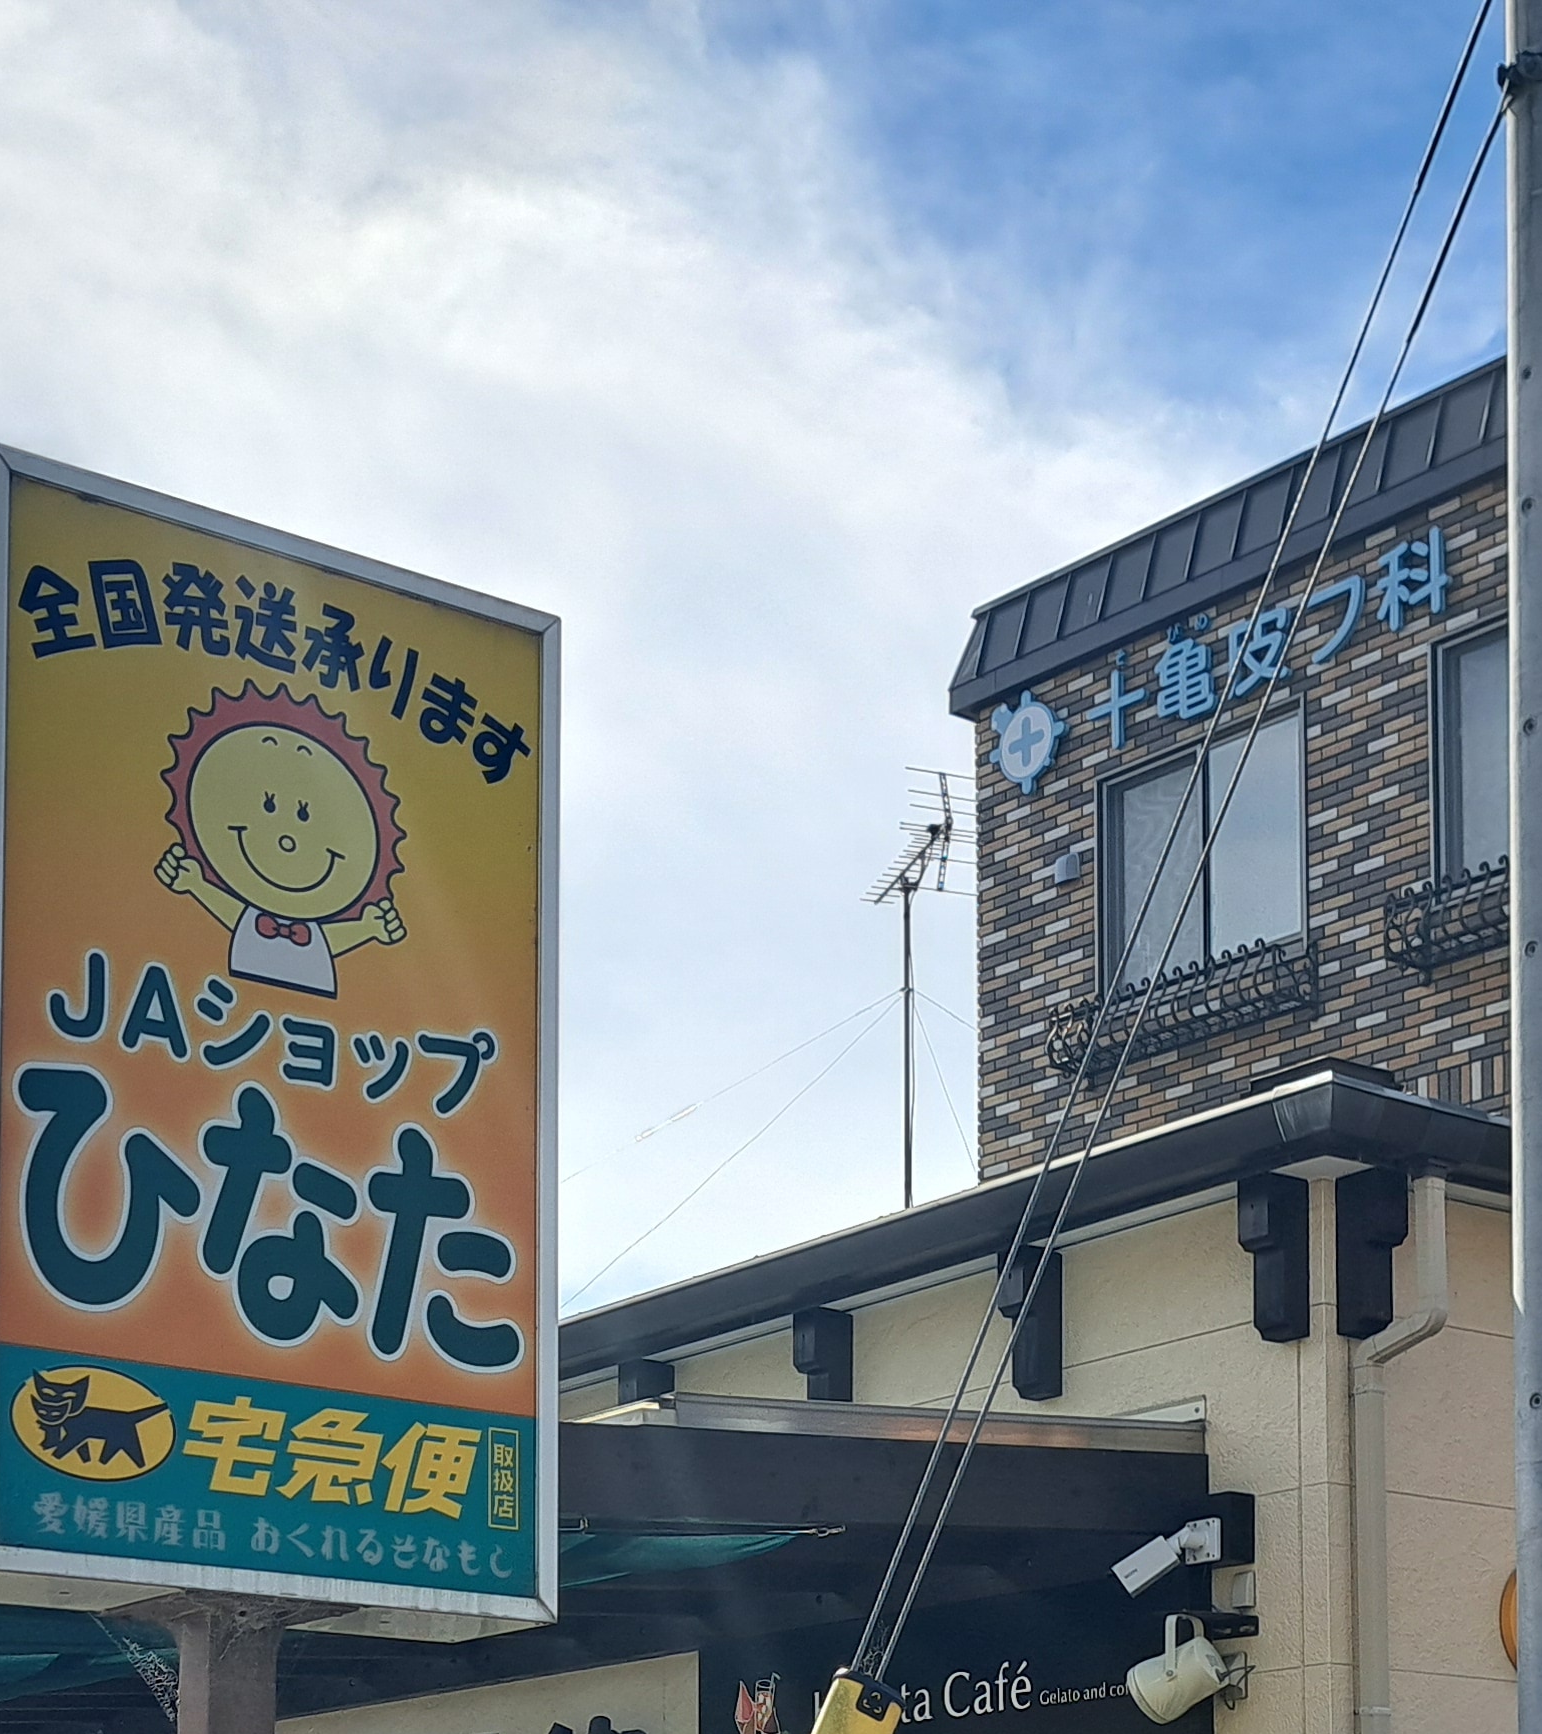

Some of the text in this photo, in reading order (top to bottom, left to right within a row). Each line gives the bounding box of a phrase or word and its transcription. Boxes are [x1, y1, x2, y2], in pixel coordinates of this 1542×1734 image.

[16, 557, 532, 785] 全国発送承ります
[1086, 525, 1452, 751] 十亀皮フ科
[49, 951, 496, 1117] JAショップ
[17, 1064, 523, 1370] ひなた
[182, 1396, 483, 1520] 宅急便
[492, 1442, 515, 1521] 取扱店
[31, 1493, 514, 1580] 愛媛県産品 おくれるそなもし
[944, 1660, 1033, 1719] Café
[1039, 1686, 1081, 1707] Gelato
[1083, 1681, 1107, 1701] and
